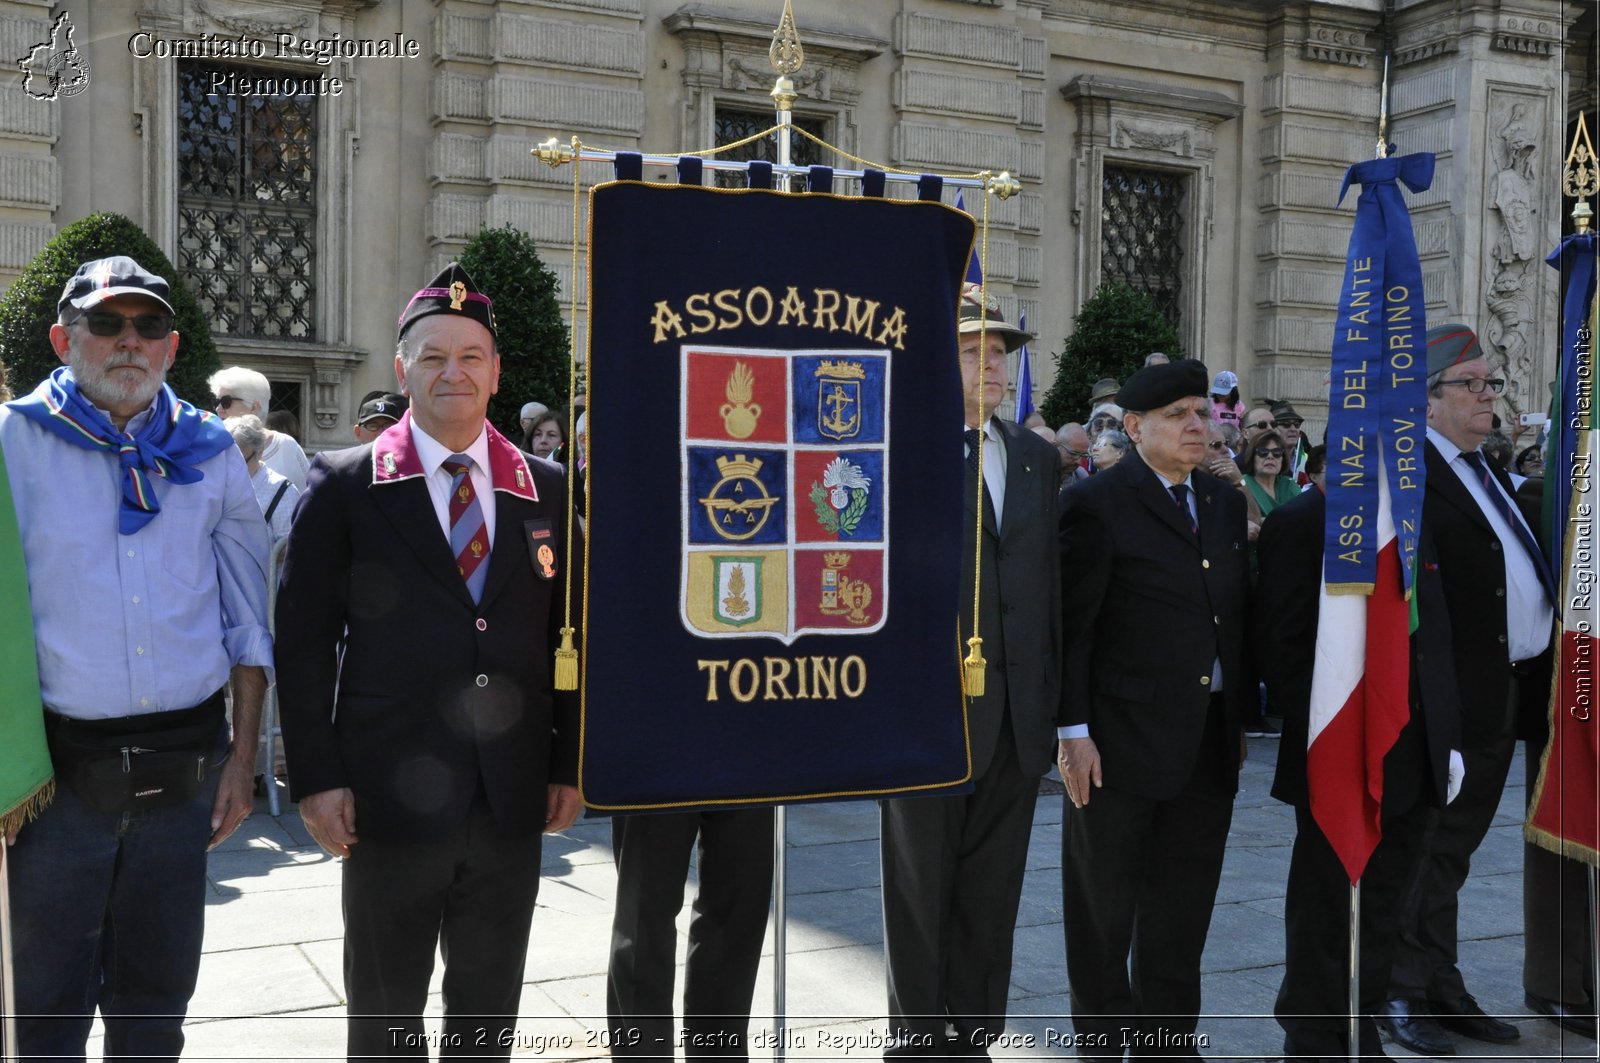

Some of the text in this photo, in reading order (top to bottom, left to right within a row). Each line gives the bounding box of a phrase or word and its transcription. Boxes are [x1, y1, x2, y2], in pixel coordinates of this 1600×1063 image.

[650, 286, 908, 350] ASSOARMA
[1386, 285, 1415, 389] TORINO
[1338, 256, 1372, 565] ASS. NAZ. DEL FANTE
[1393, 407, 1417, 490] PROV.
[697, 655, 867, 702] TORINO
